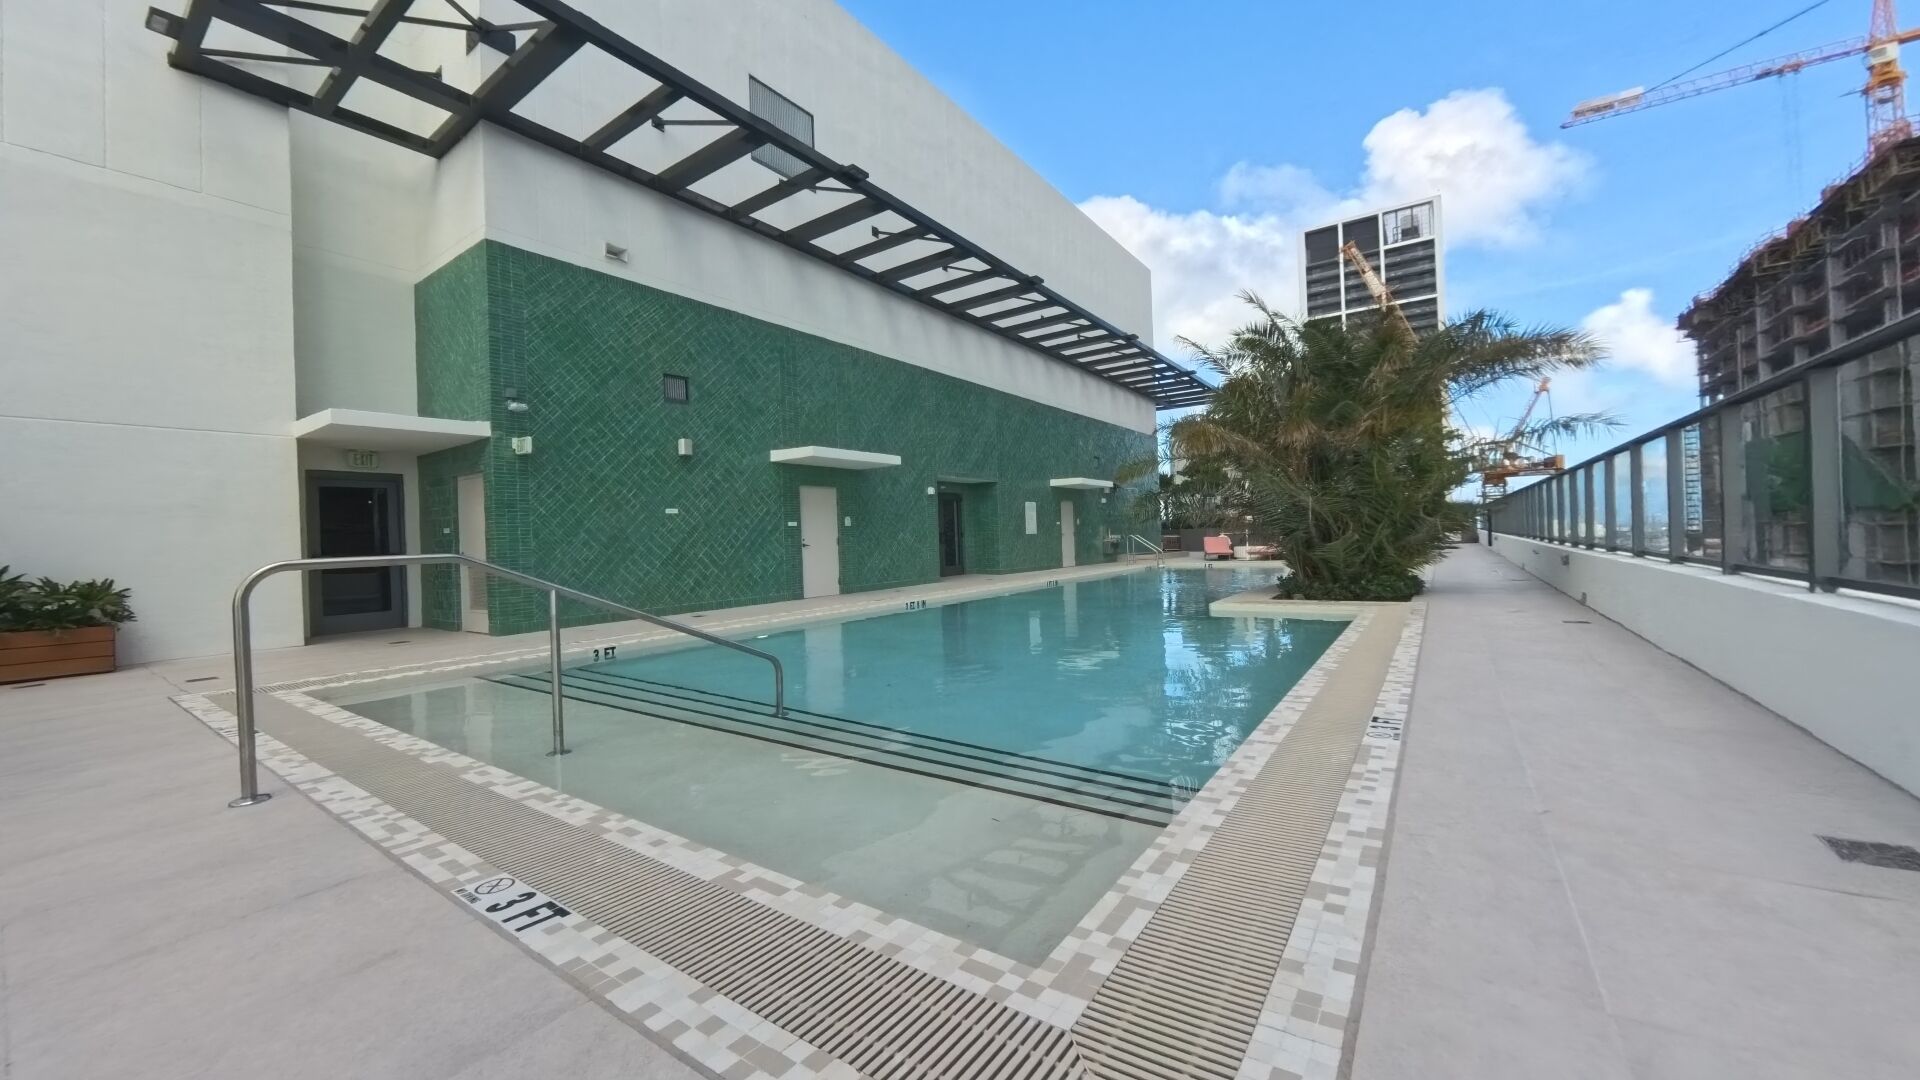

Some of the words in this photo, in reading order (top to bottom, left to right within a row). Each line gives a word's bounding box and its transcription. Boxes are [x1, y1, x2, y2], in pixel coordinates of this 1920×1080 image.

[604, 646, 616, 659] FT
[485, 891, 537, 913] 3
[502, 900, 572, 933] FT
